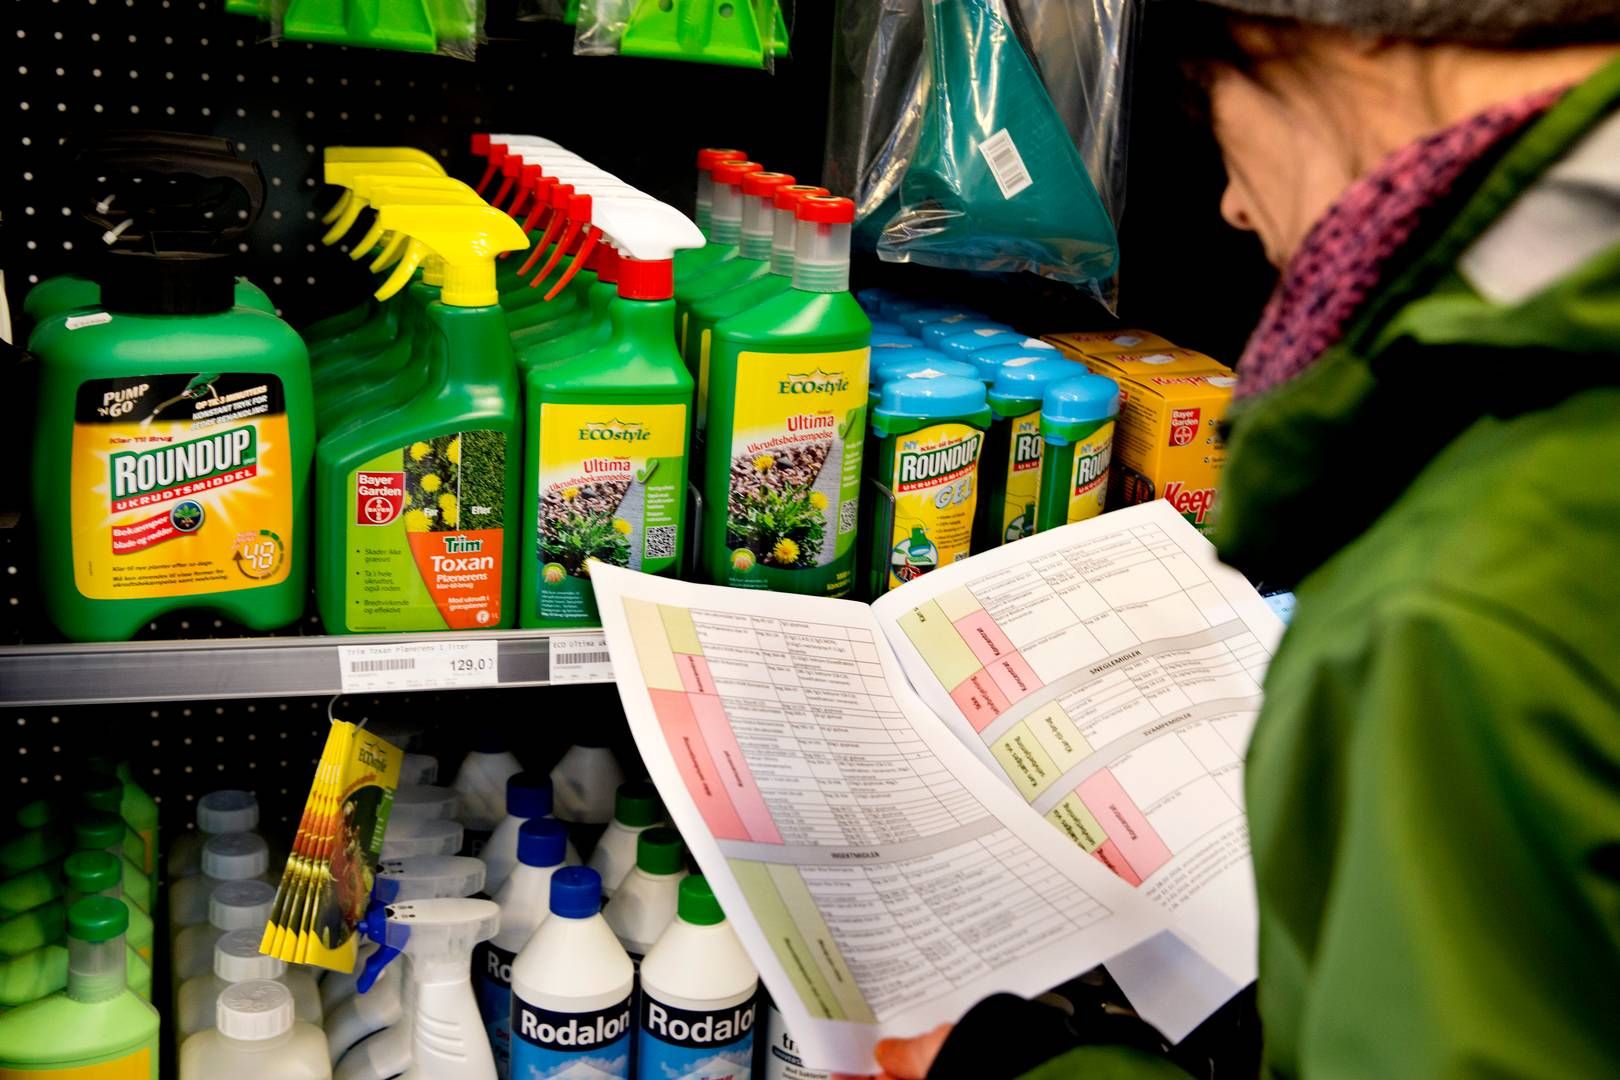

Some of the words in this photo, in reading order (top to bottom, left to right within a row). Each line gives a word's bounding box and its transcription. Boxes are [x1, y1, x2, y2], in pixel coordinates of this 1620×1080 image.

[103, 383, 150, 406] PUMP
[778, 380, 848, 396] ECOstyle
[787, 414, 835, 432] Ultima
[578, 428, 651, 444] ECOstyle
[114, 428, 251, 497] ROUNDUP
[583, 458, 631, 473] Ultima
[901, 436, 979, 482] ROUNDUP
[116, 469, 254, 511] UKRUDTSMIDDEL
[359, 474, 394, 487] Bayer
[359, 486, 402, 497] Garden
[444, 534, 482, 553] Trim
[243, 541, 275, 570] 48
[430, 555, 494, 572] Toxan
[976, 626, 1000, 657] Koncentrat
[1089, 650, 1142, 676] SNEGLEMIDLER
[521, 1009, 630, 1045] Rodalon
